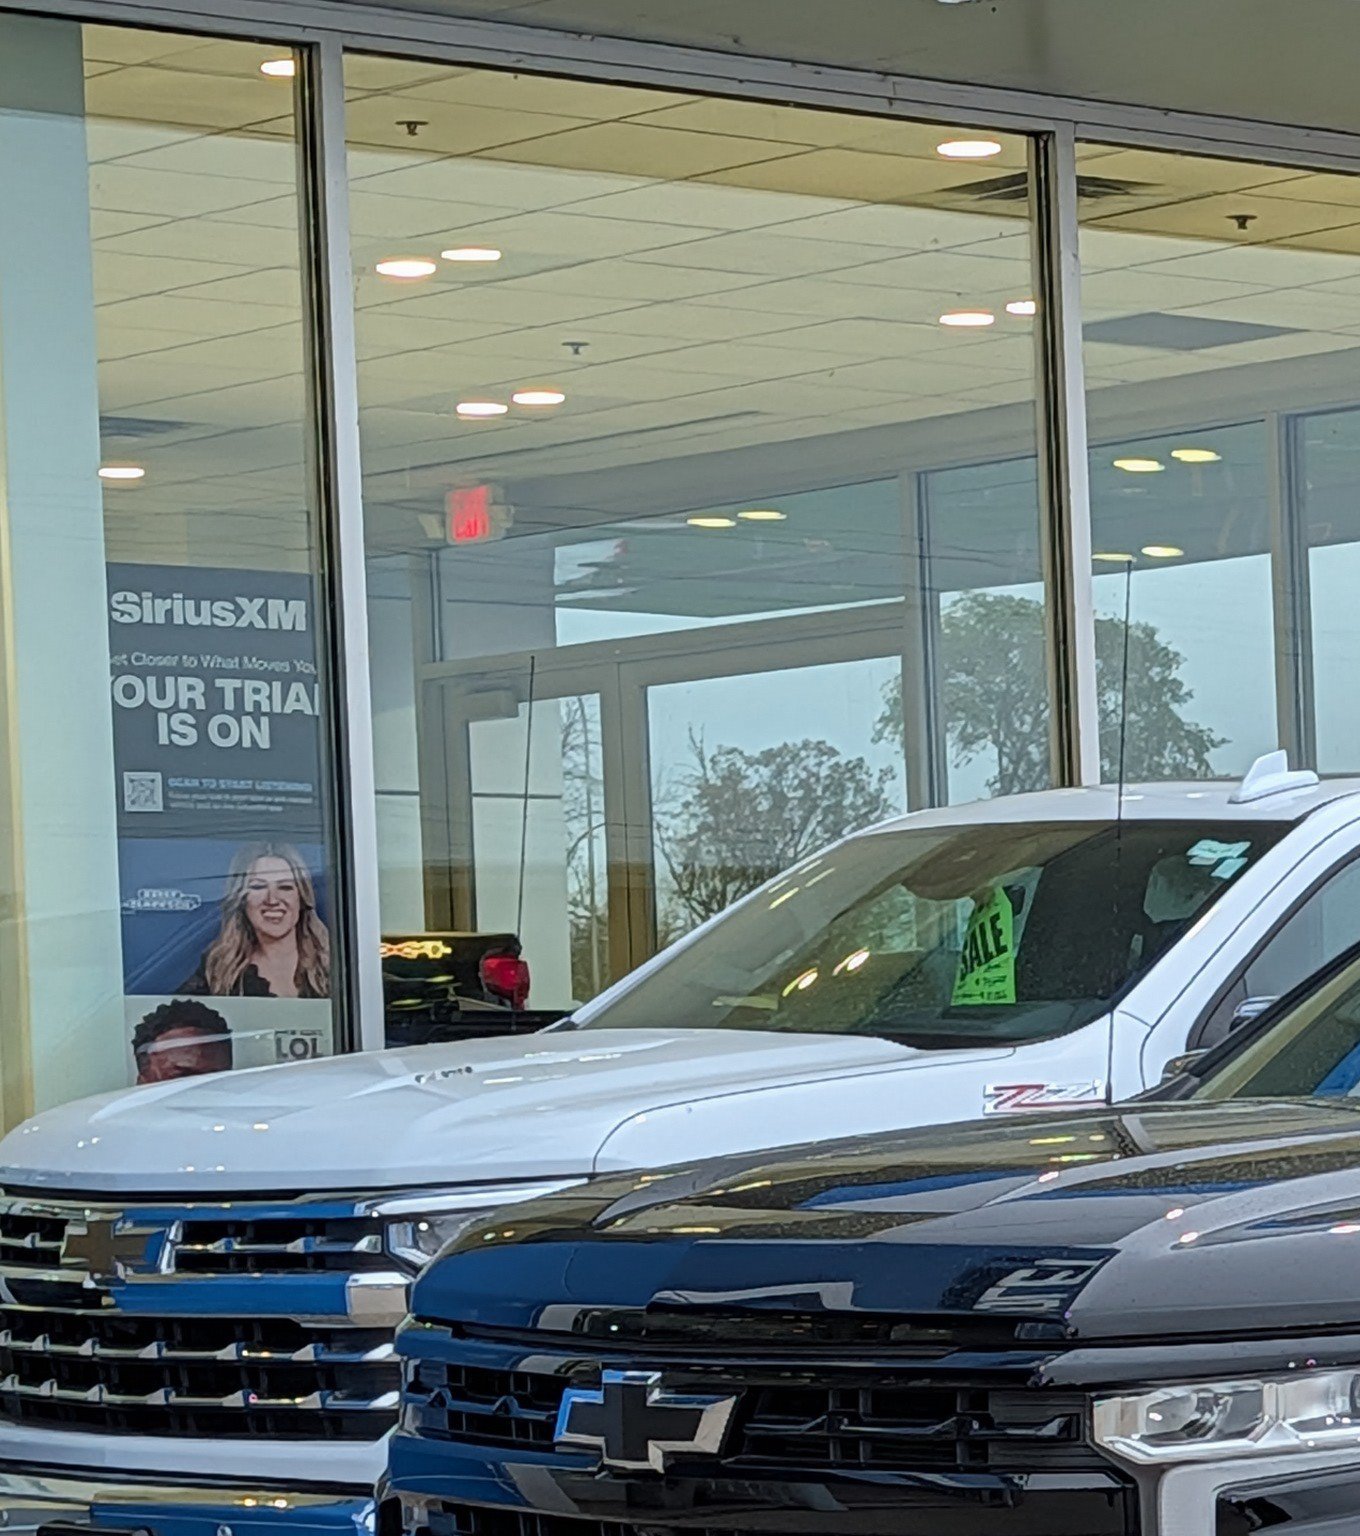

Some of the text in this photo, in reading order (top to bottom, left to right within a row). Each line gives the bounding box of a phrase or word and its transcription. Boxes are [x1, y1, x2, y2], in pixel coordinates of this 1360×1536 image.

[111, 591, 306, 631] SiriusXM
[111, 653, 127, 667] et
[182, 655, 198, 668] to
[111, 674, 206, 710] OUR
[157, 712, 271, 749] IS ON
[960, 912, 1008, 982] SALE
[275, 1037, 323, 1062] LOL
